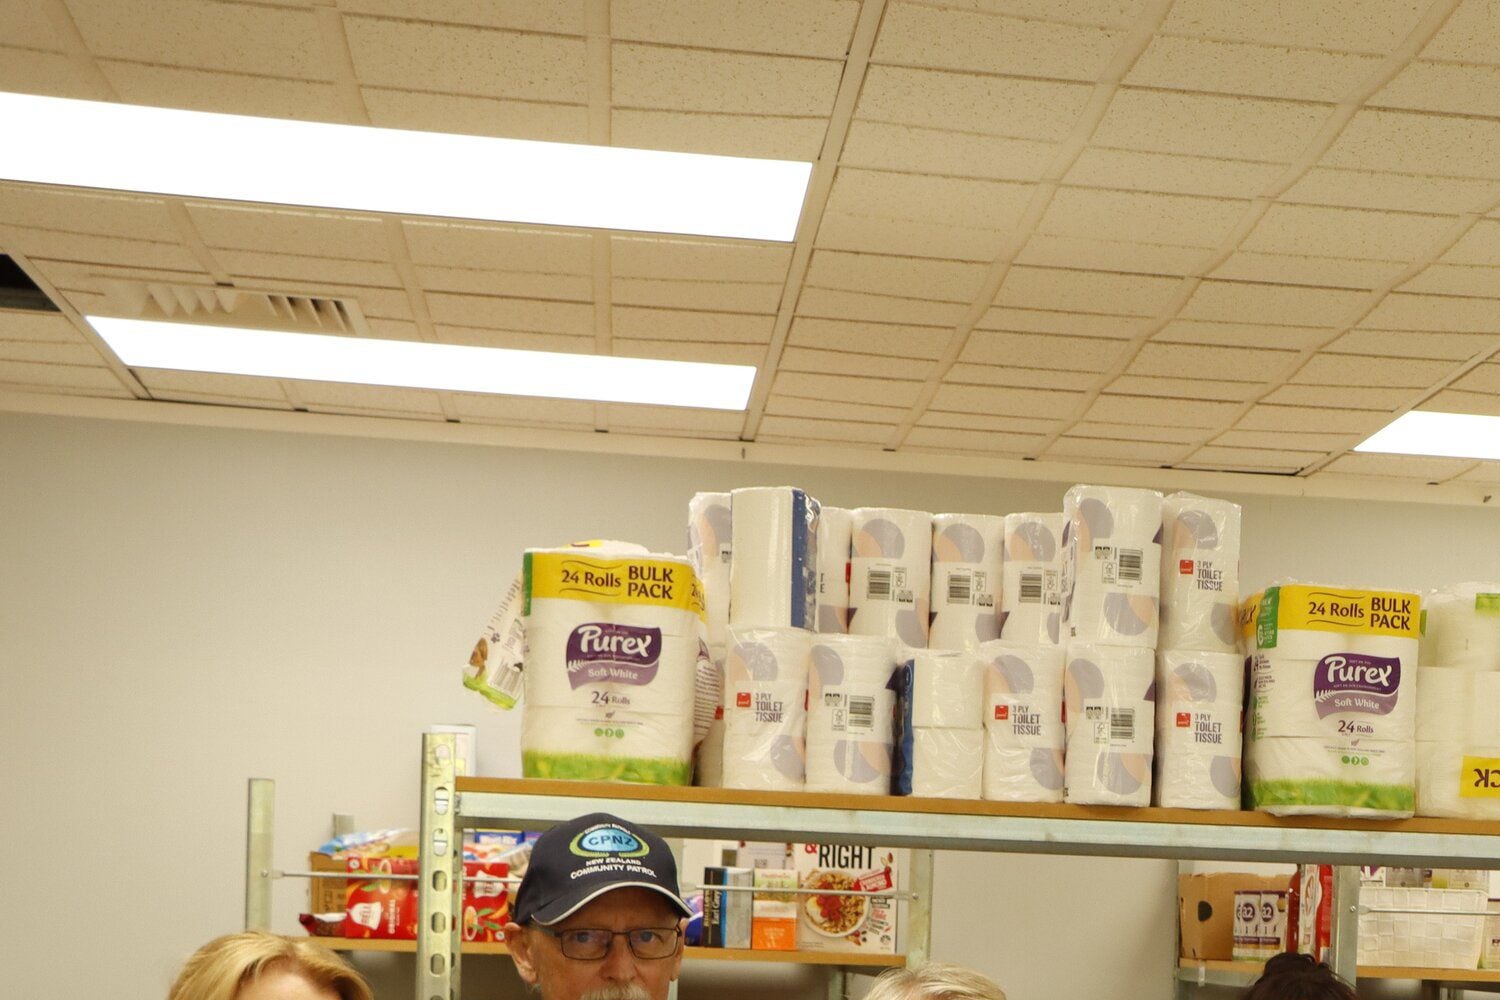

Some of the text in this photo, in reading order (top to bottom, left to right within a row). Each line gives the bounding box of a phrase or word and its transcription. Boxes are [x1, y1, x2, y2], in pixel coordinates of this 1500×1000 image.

[1202, 561, 1213, 569] PLY
[561, 565, 674, 588] 24 Rolls BULK
[1197, 569, 1222, 580] TOILET
[627, 582, 673, 600] PACK
[1197, 580, 1222, 592] TISSUE
[1308, 597, 1411, 618] 24 Rolls BULK
[1370, 614, 1410, 630] PACK
[578, 625, 652, 657] Purex
[588, 668, 639, 680] Soft White
[1324, 656, 1392, 687] Purex
[591, 691, 630, 705] 24 Rolls
[1335, 699, 1380, 709] Soft White
[755, 701, 783, 712] TOILET
[1018, 705, 1029, 713] PLY
[755, 712, 783, 723] TISSUE
[1013, 714, 1041, 724] TOILET
[1200, 713, 1211, 721] PLY
[1013, 725, 1041, 736] TISSUE
[1195, 722, 1222, 733] TOILET
[1338, 720, 1374, 733] 24 Rolls
[1195, 732, 1222, 744] TISSUE
[588, 834, 632, 846] CPNZ
[586, 857, 642, 866] NEW ZEALAND
[819, 844, 876, 870] RIGHT
[570, 864, 657, 879] COMMUNITY PATROL
